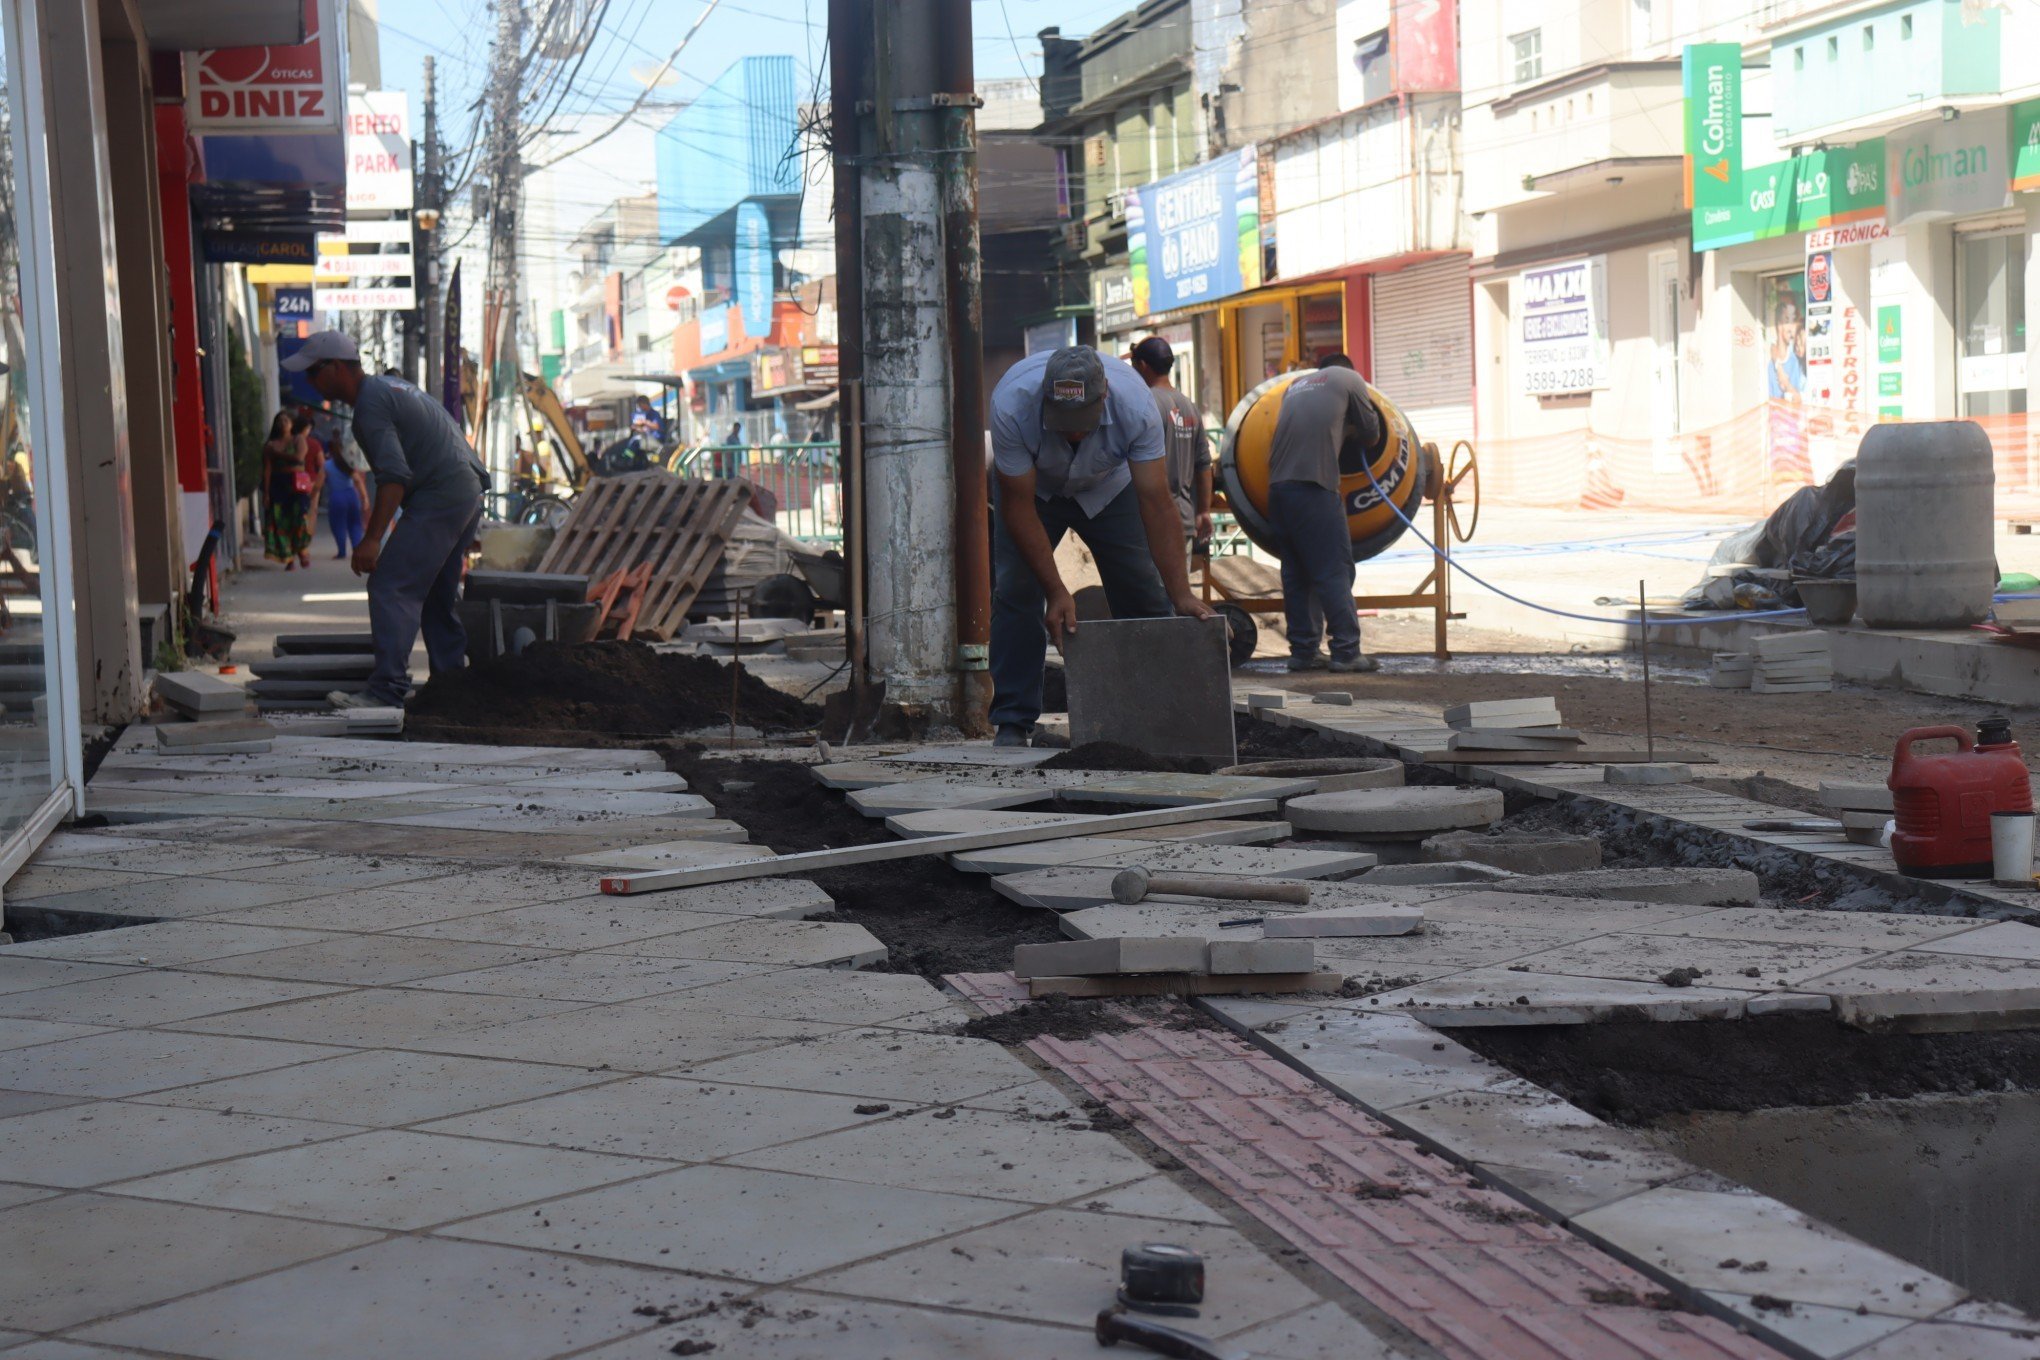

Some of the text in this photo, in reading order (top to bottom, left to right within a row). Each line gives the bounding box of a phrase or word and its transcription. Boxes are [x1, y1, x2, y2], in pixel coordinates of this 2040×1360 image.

[271, 68, 313, 79] ÓTICAS
[200, 90, 325, 117] DINIZ
[1702, 64, 1725, 156] Colman
[354, 153, 400, 173] PARK
[1904, 142, 1988, 190] Colman
[1156, 172, 1222, 233] CENTRAL
[259, 241, 311, 257] CAROL
[1162, 220, 1219, 277] do PANO
[1809, 223, 1890, 249] ELETRÔNICA
[1524, 270, 1586, 304] MAXXI
[279, 297, 310, 313] 24h
[1525, 368, 1594, 390] 3589-2288
[1842, 306, 1861, 435] ELETRÔNICA
[1353, 468, 1400, 509] CSM
